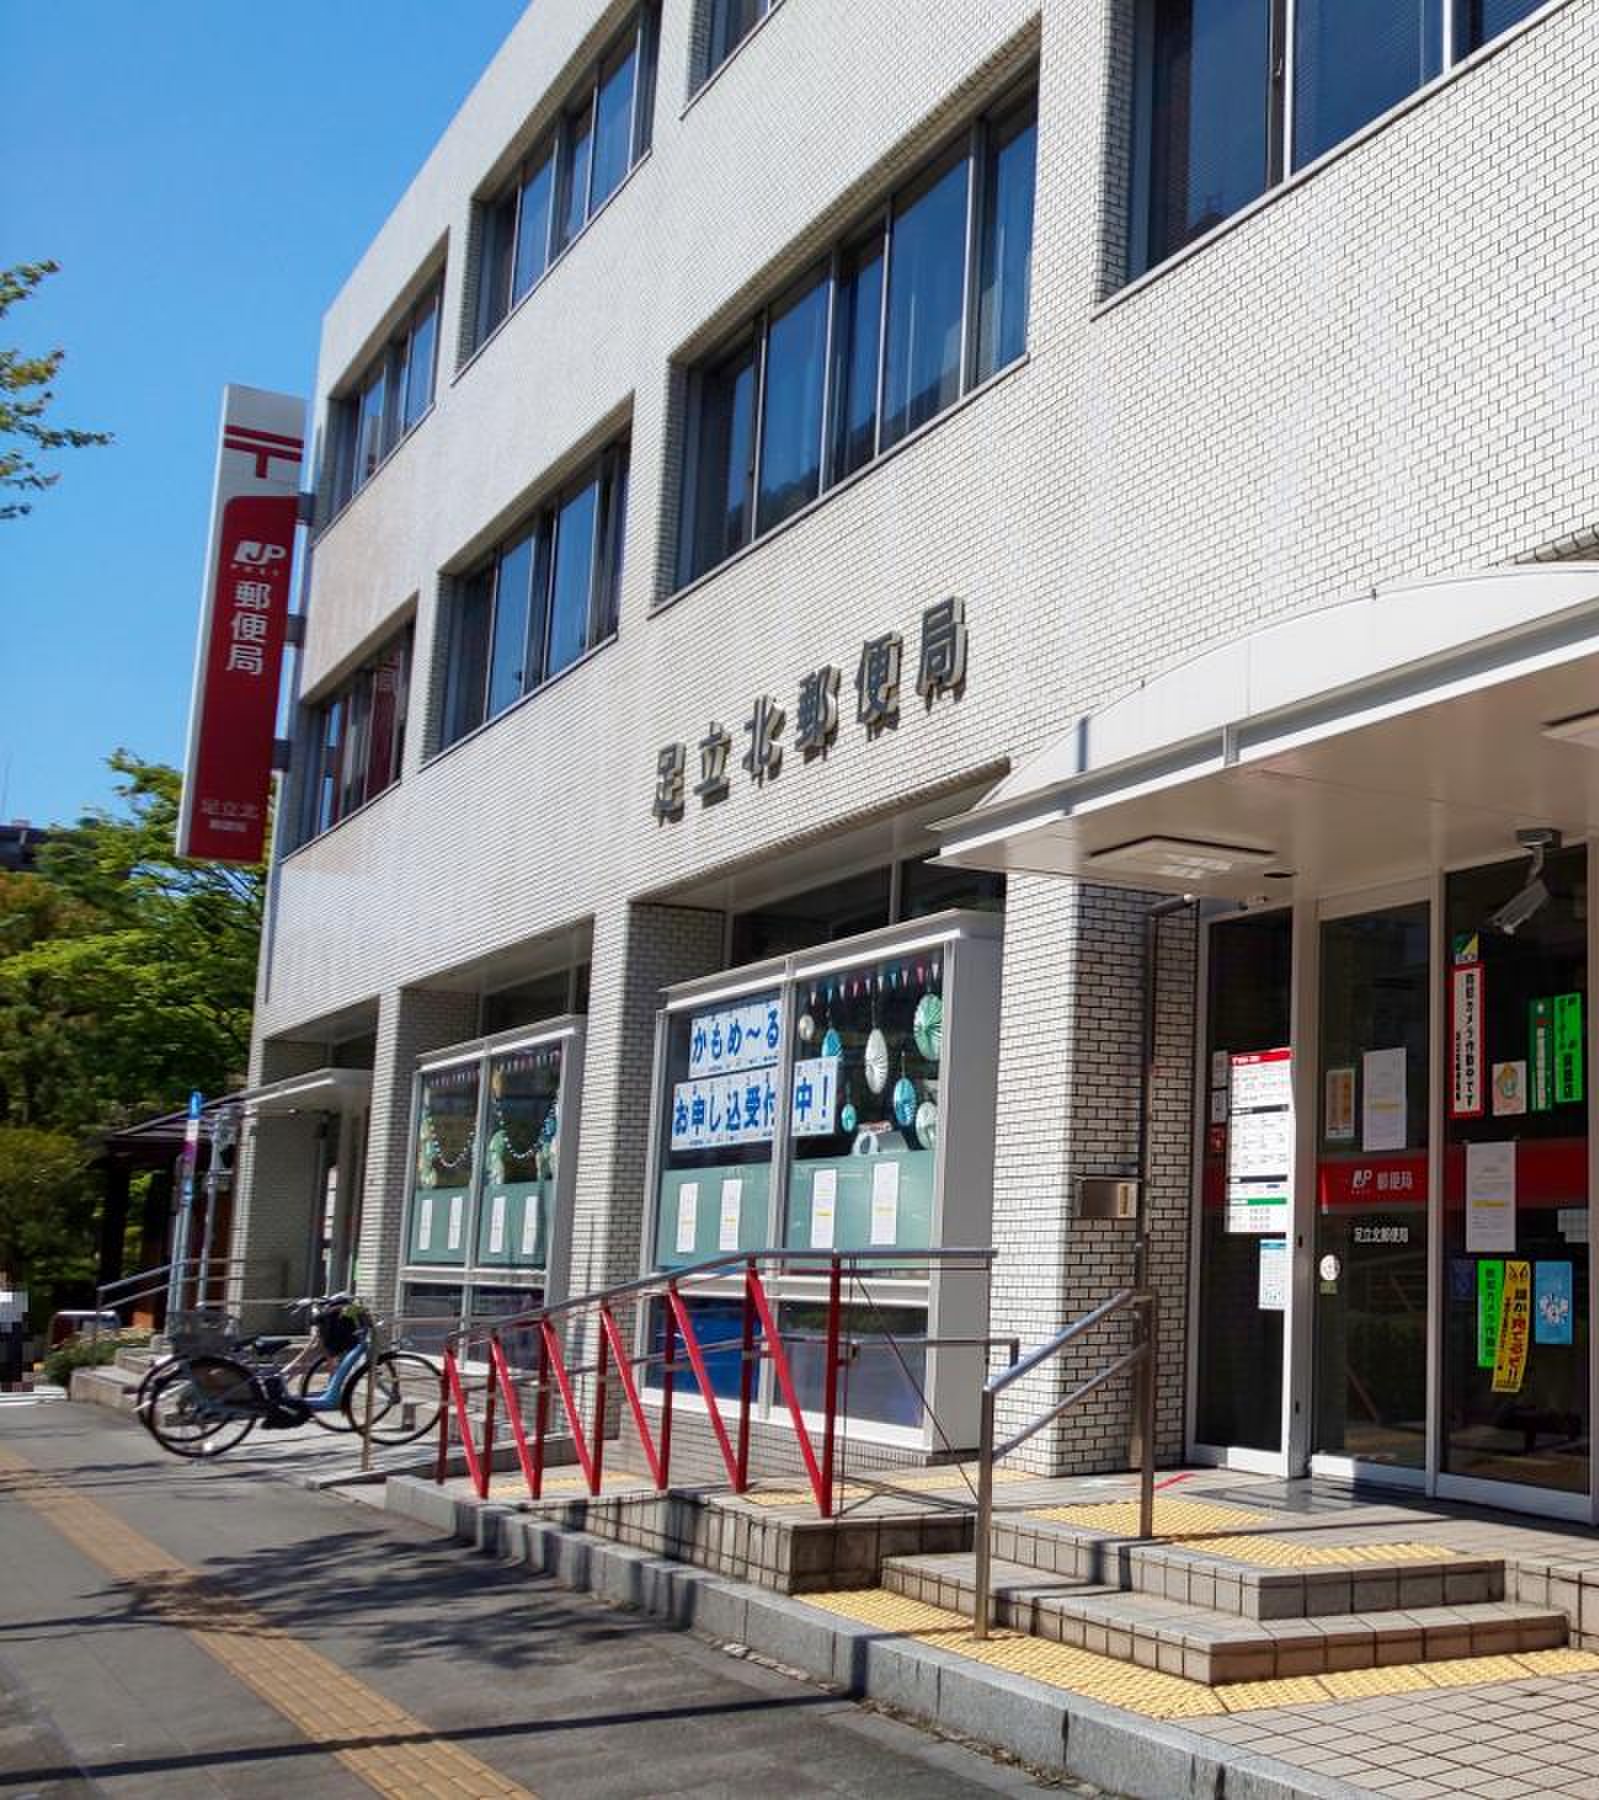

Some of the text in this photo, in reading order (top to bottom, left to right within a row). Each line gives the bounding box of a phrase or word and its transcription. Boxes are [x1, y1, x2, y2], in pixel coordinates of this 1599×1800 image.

[225, 581, 272, 676] 郵便局
[652, 596, 968, 822] 足立北郵便局
[1376, 1170, 1413, 1191] 郵便局
